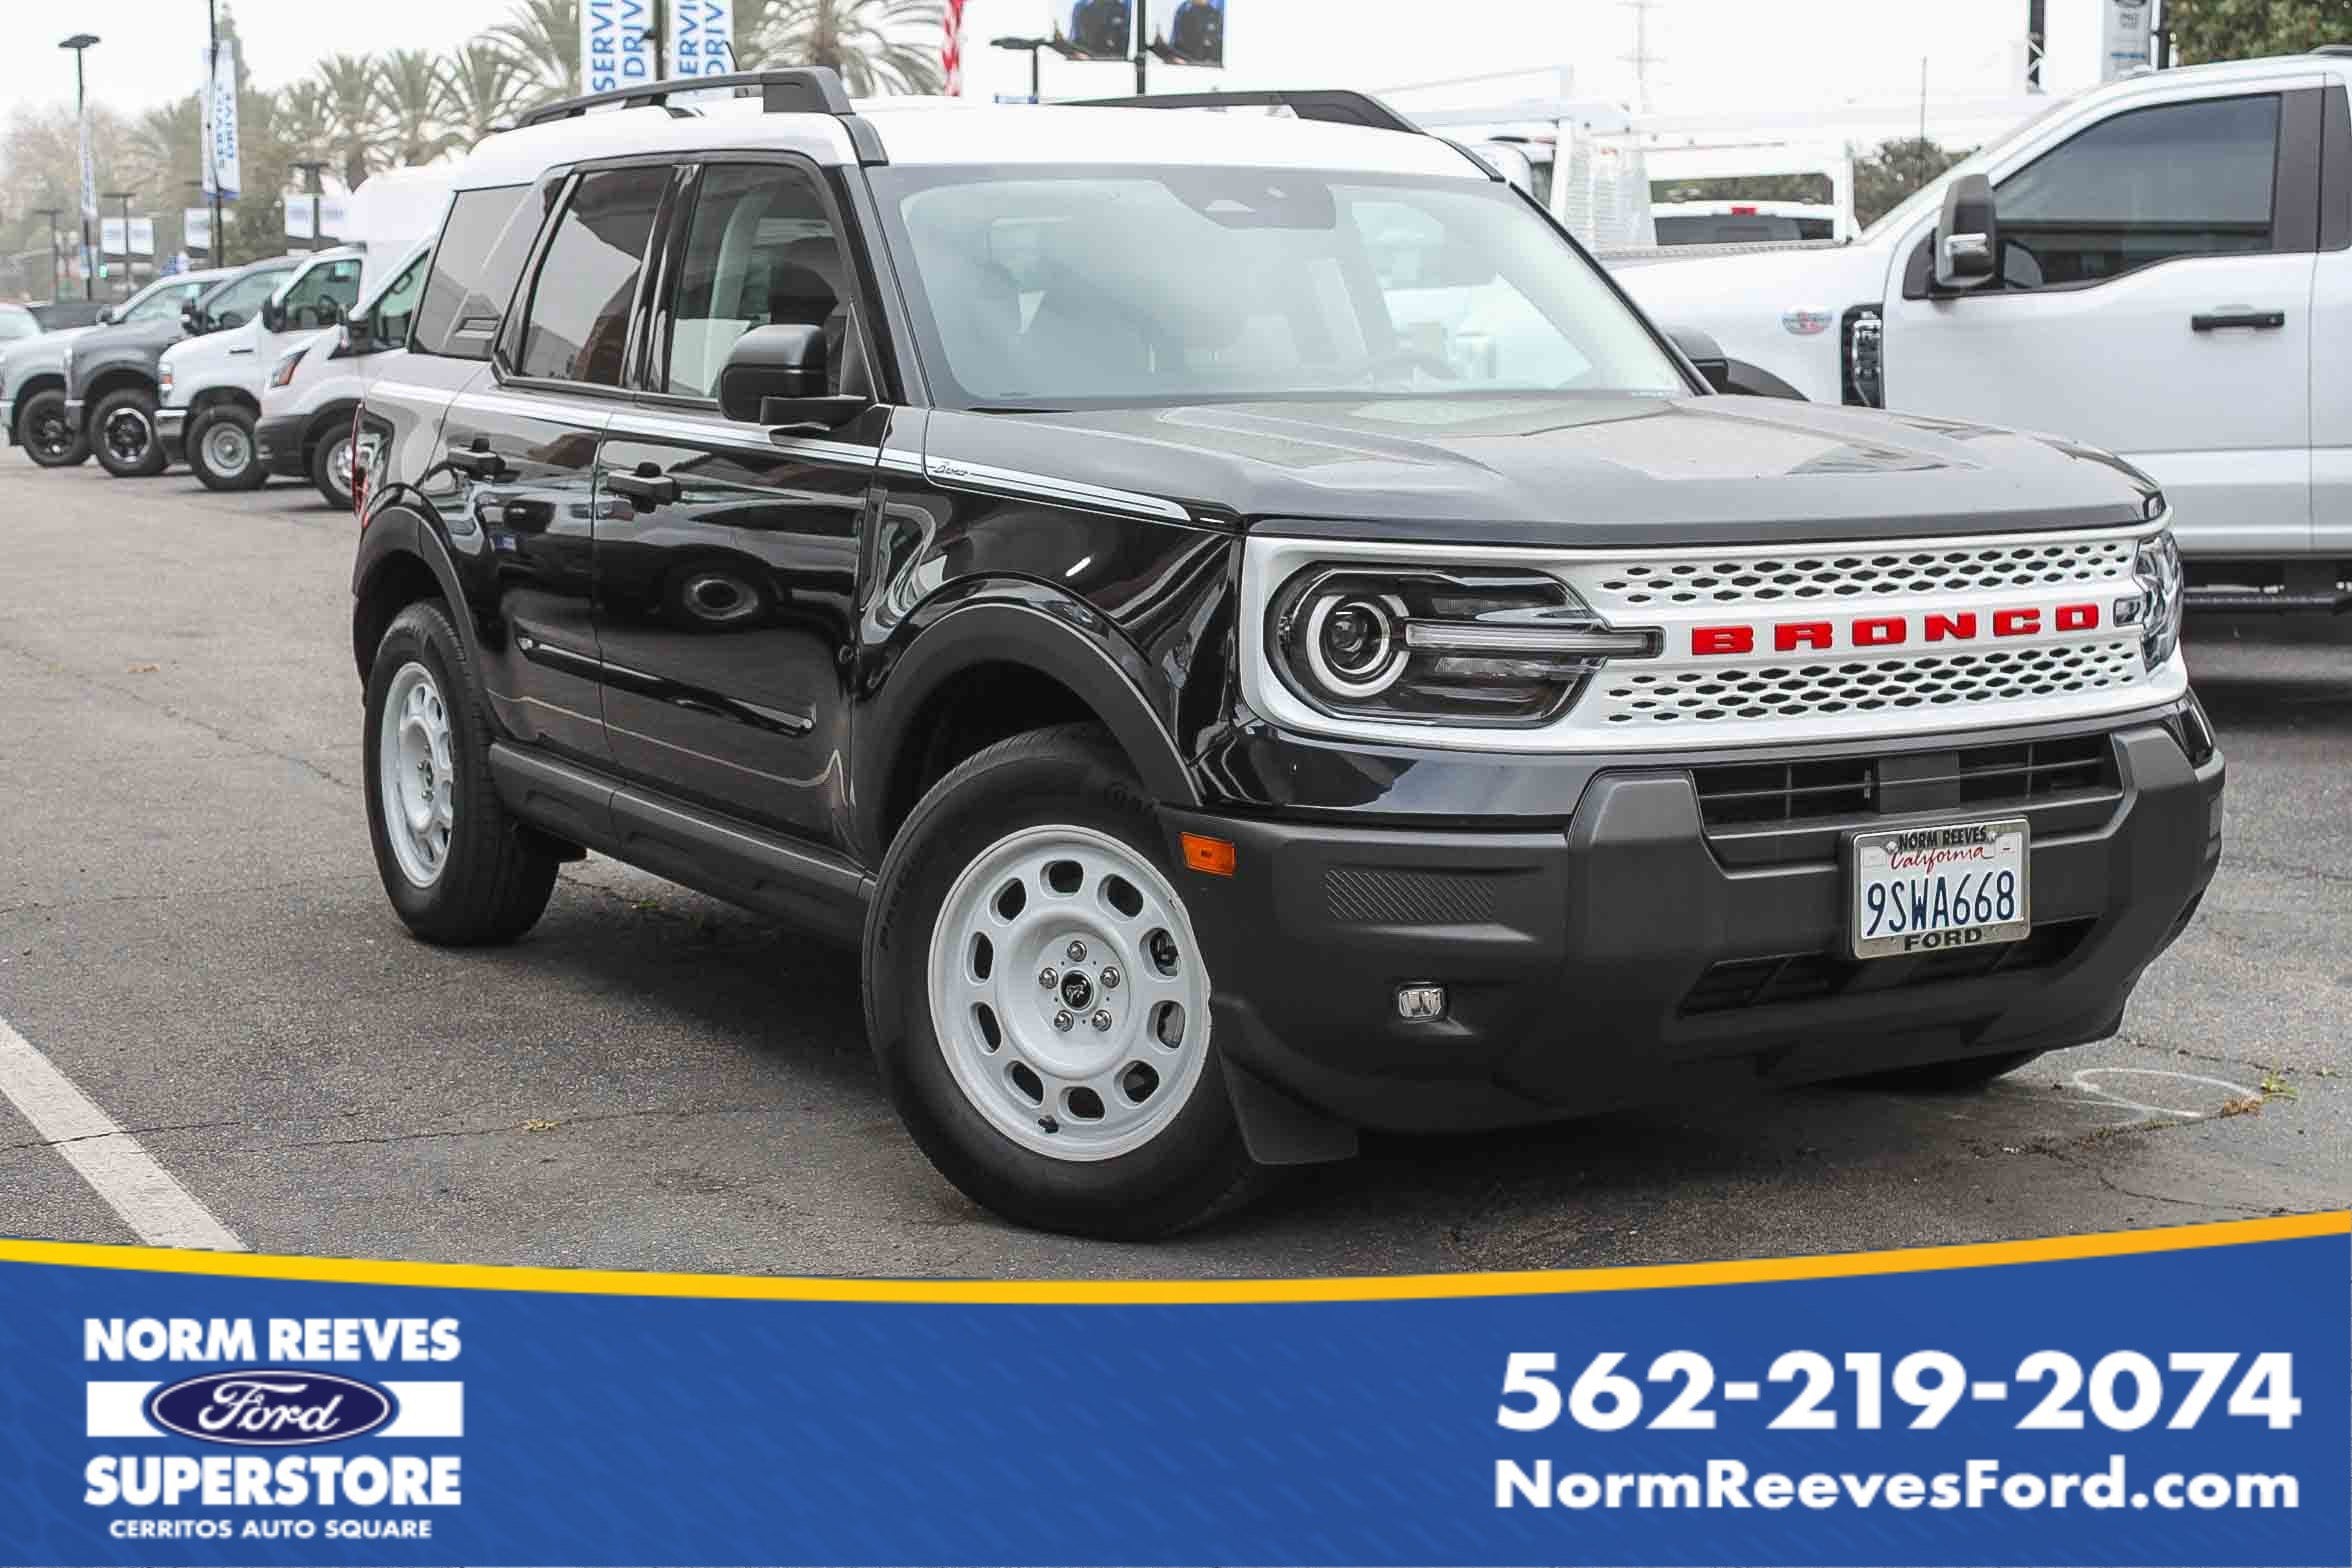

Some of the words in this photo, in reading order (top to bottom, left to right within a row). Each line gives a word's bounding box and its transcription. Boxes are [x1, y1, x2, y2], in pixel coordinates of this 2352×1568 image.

[679, 4, 699, 75] ERVI
[1691, 602, 2100, 657] BRONCO
[1899, 829, 1940, 850] NORM
[1942, 826, 1988, 846] REEVES
[1888, 845, 1987, 875] California
[1866, 869, 2016, 937] 9SWA668
[1903, 927, 1983, 951] FORD
